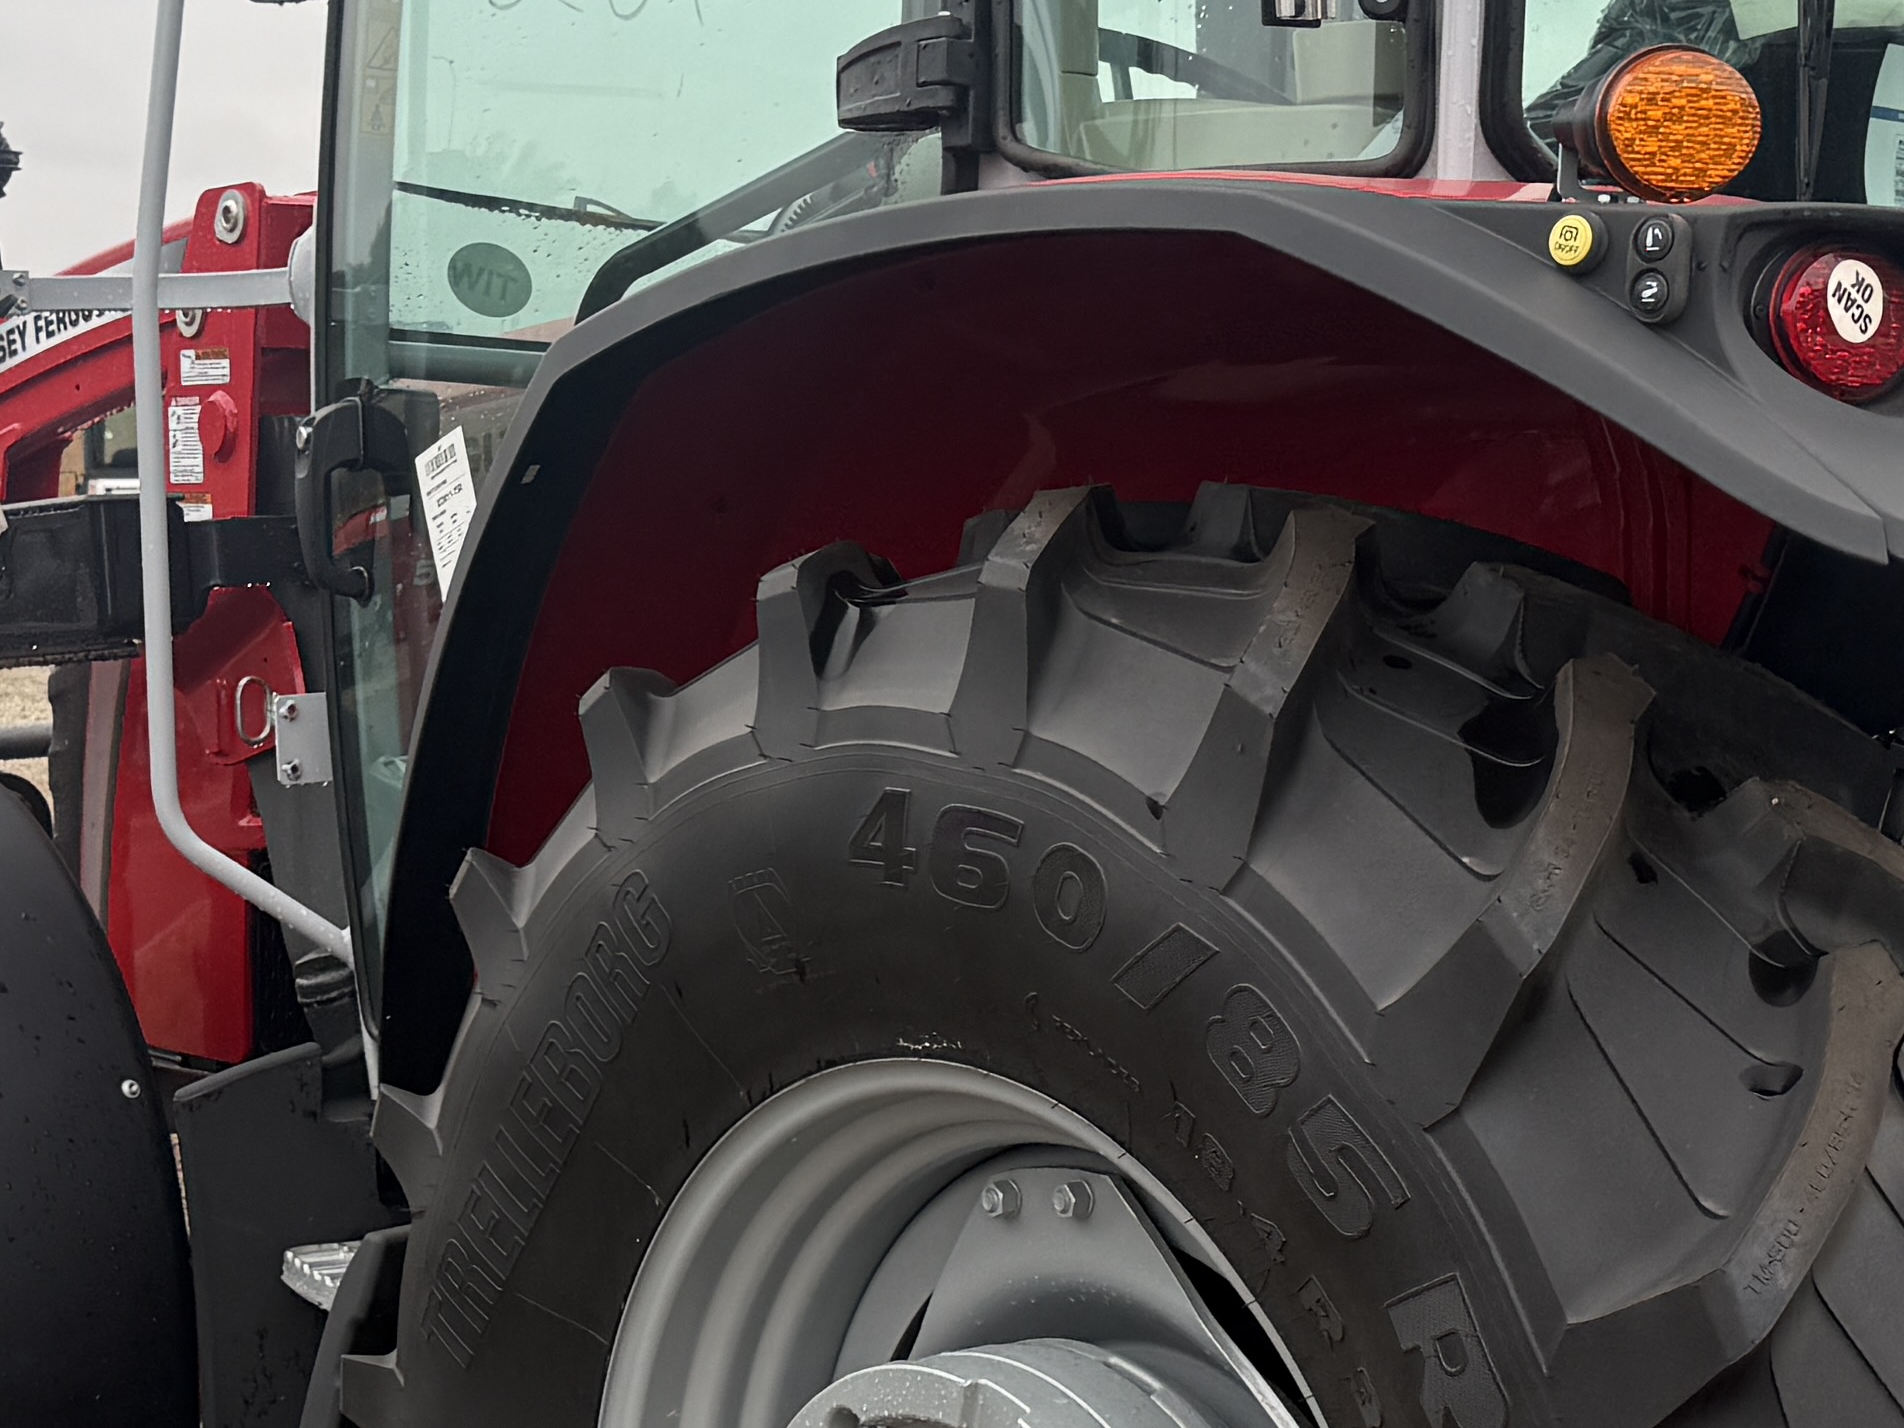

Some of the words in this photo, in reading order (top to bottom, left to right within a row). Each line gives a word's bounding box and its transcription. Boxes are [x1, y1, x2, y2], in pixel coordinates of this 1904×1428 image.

[1832, 280, 1872, 335] SCAN
[1850, 268, 1874, 304] OK
[421, 869, 672, 1371] TRELLEBORG
[848, 786, 1410, 1239] 460/85
